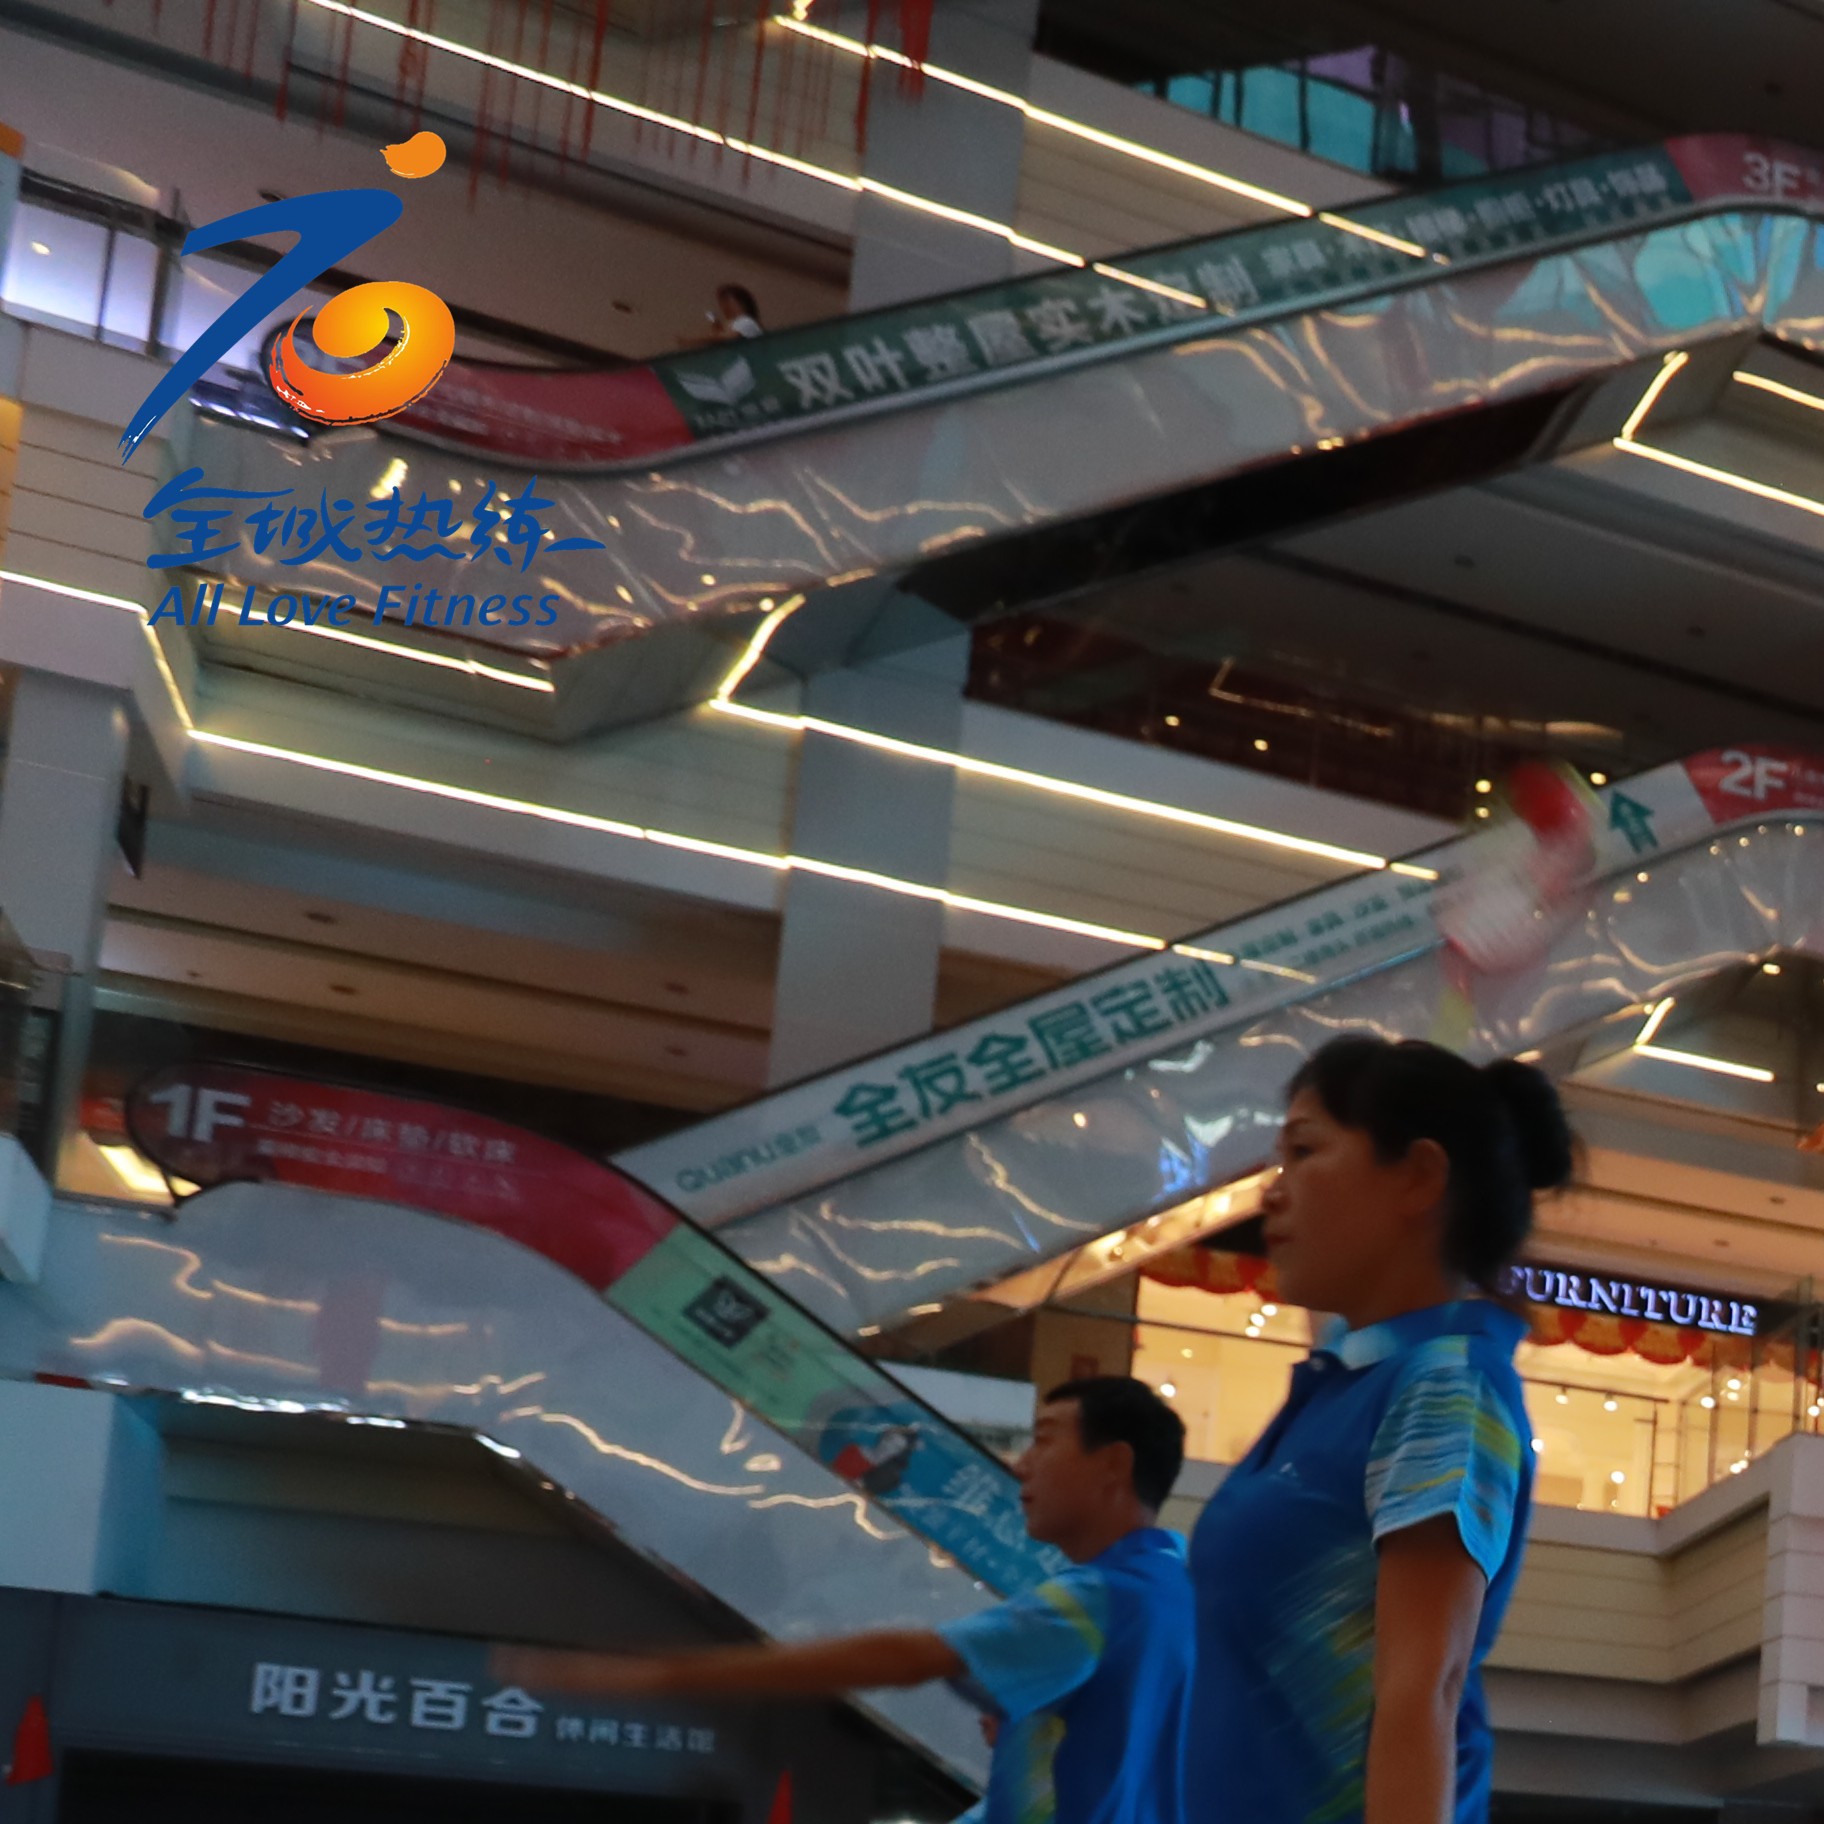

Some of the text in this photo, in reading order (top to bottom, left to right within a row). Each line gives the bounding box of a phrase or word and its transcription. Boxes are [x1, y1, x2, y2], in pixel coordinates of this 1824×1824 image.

[1741, 151, 1800, 202] 3F
[1718, 750, 1789, 801] 2F
[832, 962, 1230, 1149] 全友全屋定制
[150, 1083, 252, 1142] 1F
[250, 1661, 545, 1739] 阳光百合
